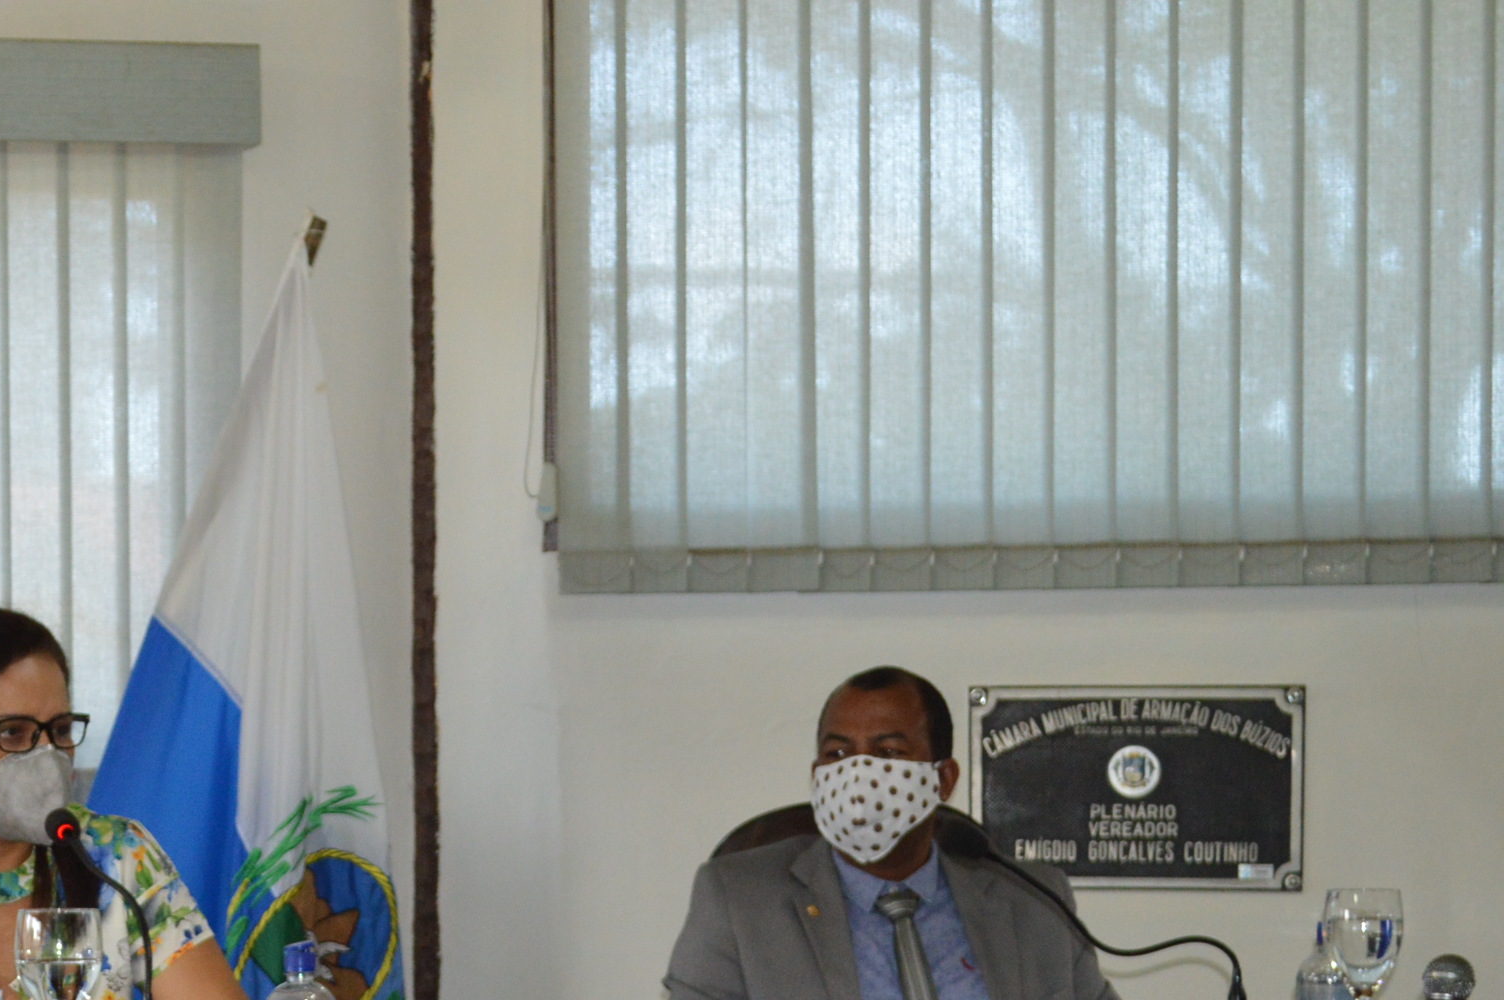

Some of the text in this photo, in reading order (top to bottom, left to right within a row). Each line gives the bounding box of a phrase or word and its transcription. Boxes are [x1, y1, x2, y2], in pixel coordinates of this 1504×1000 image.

[983, 699, 1292, 760] CÂMARA MUNICIPAL DE ARMAÇÃO DOS BÚZIOS
[1089, 802, 1177, 820] PLENÁRIO
[1087, 820, 1179, 838] VEREADOR
[1014, 836, 1077, 862] EMÍGDIO
[1183, 840, 1259, 864] COUTINHO
